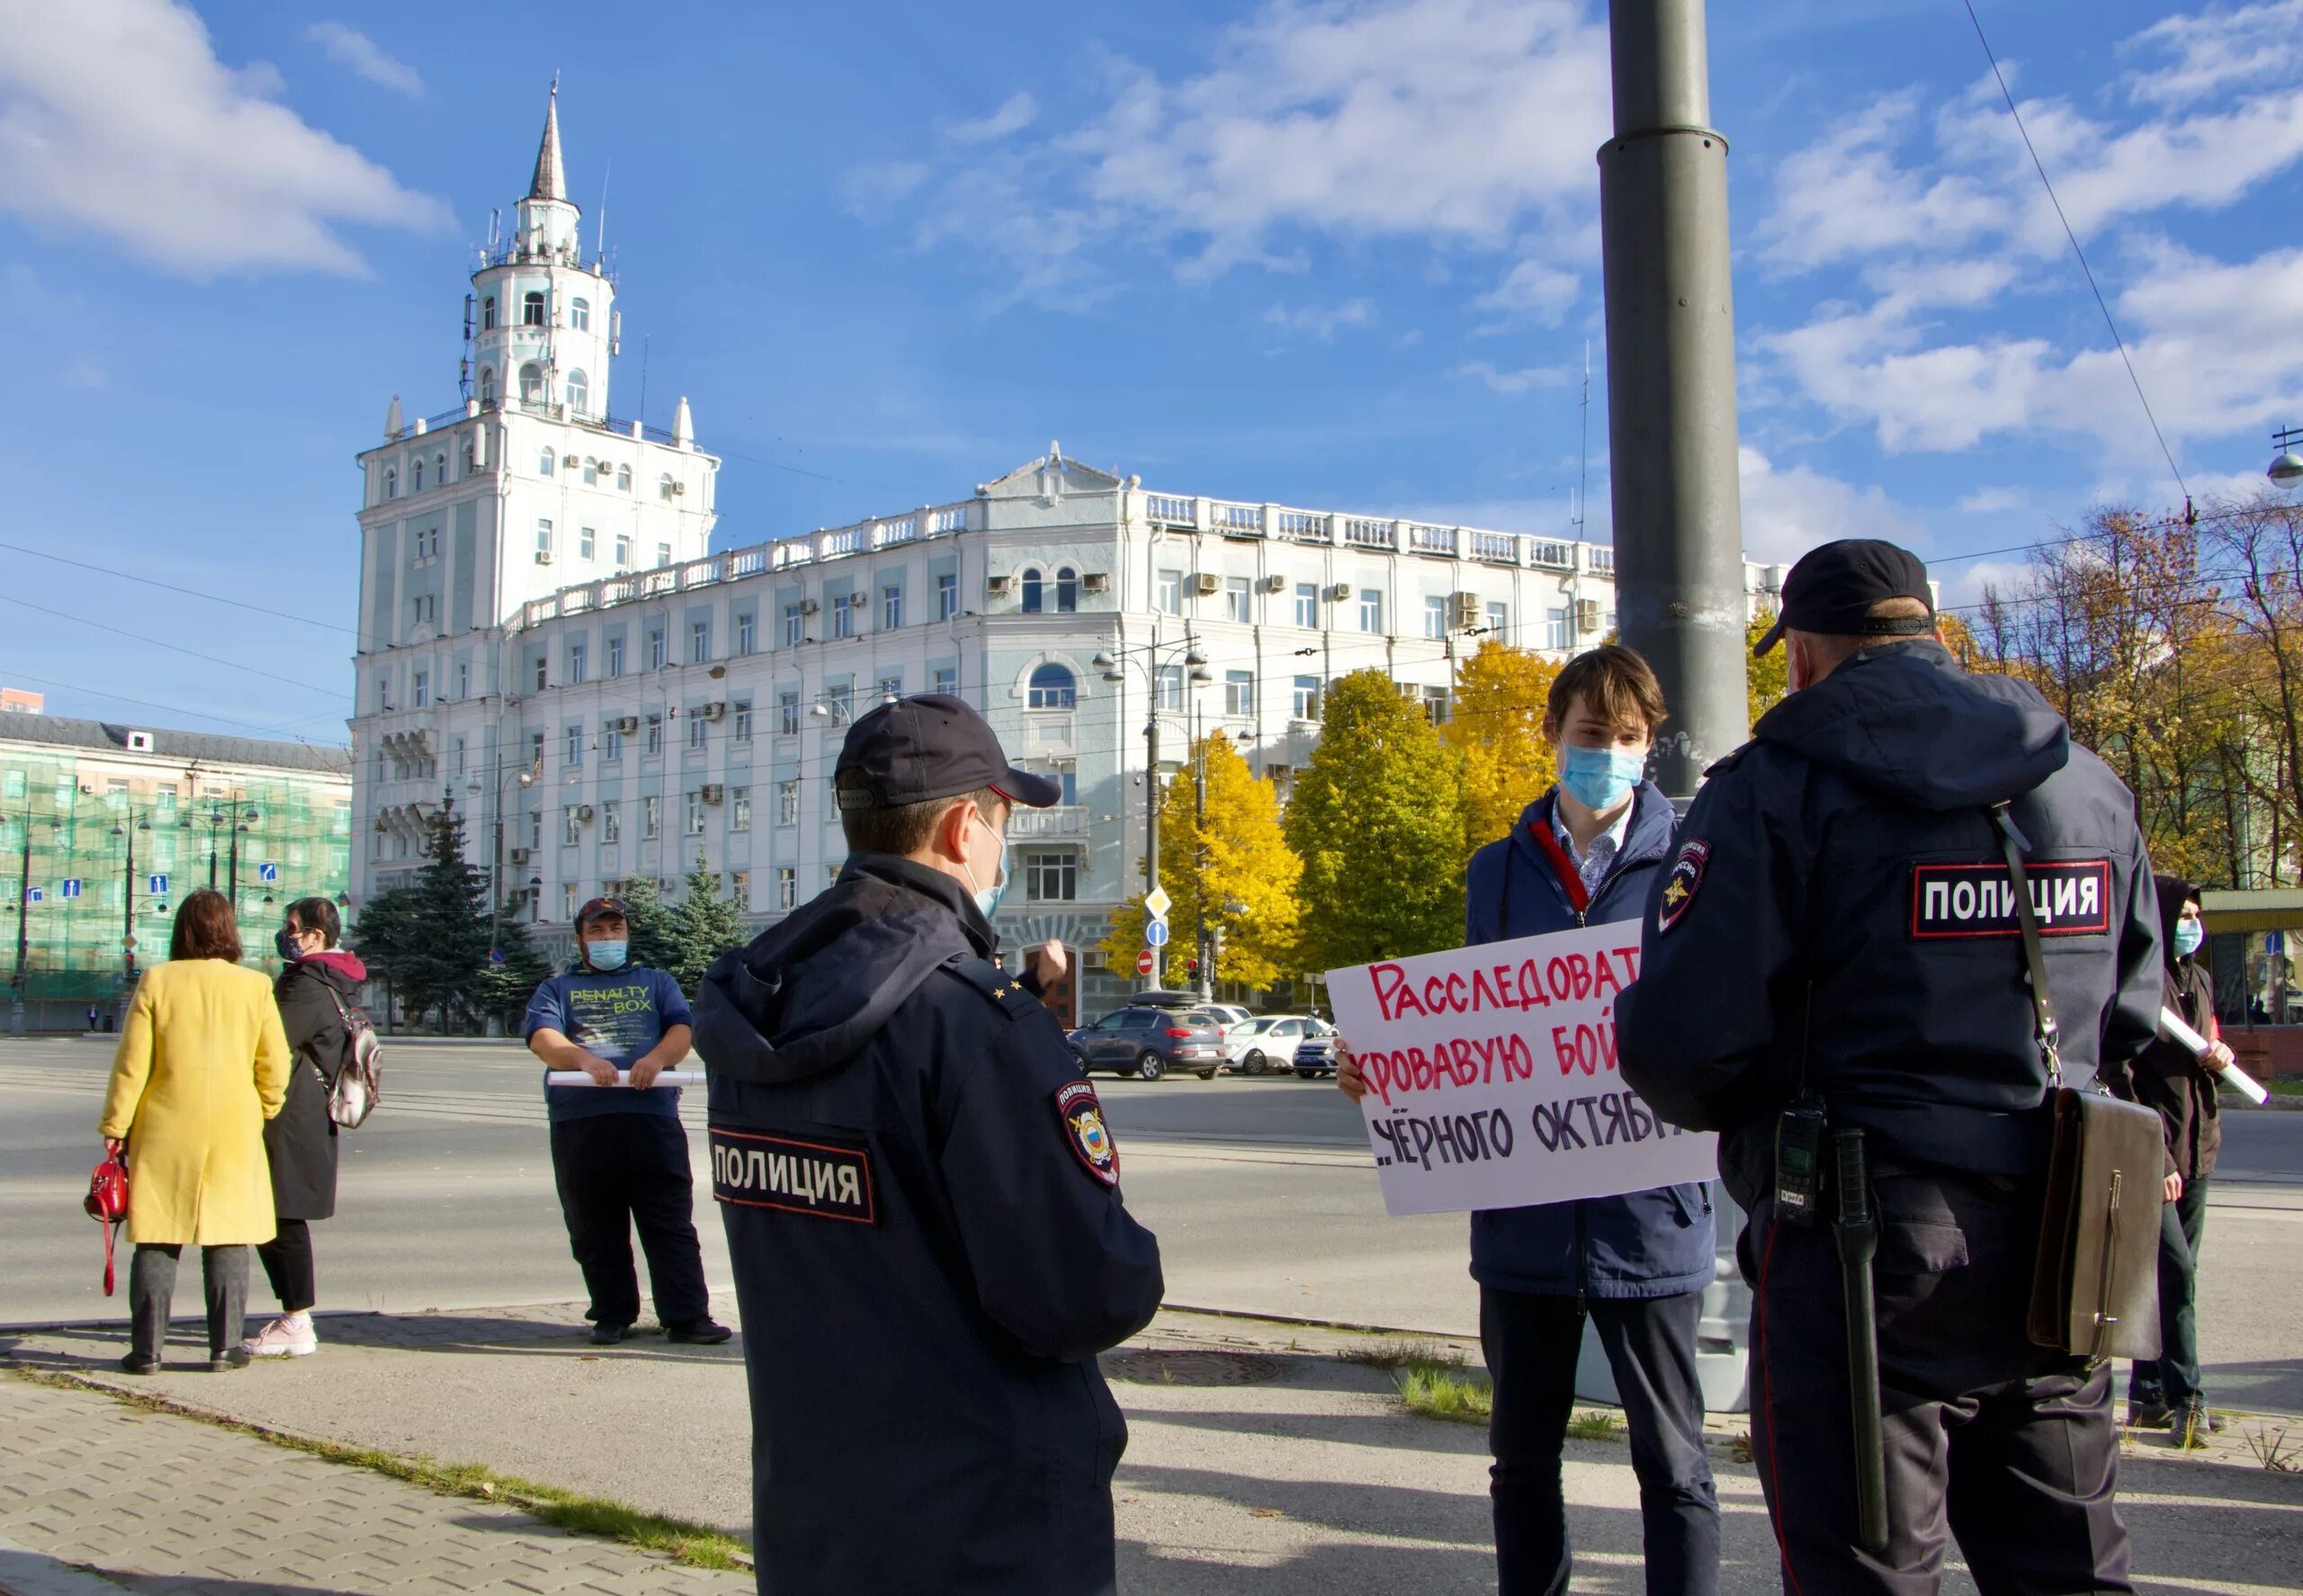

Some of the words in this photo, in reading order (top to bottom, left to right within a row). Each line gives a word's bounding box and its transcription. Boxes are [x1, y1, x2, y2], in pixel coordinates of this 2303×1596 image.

[1924, 876, 2099, 924] ПОЛИЦИЯ
[569, 986, 650, 1003] PENALTY
[614, 1000, 652, 1015] BOX
[1368, 946, 1640, 1021] РАССЛЕДОВАТ
[1349, 1034, 1533, 1107] КРОВАВУЮ
[1551, 1006, 1618, 1076] БОЙ
[1059, 1084, 1092, 1106] ПОЛИЦИЯ
[1532, 1090, 1682, 1152] ОКТЯБ
[714, 1143, 862, 1206] ПОЛИЦИЯ
